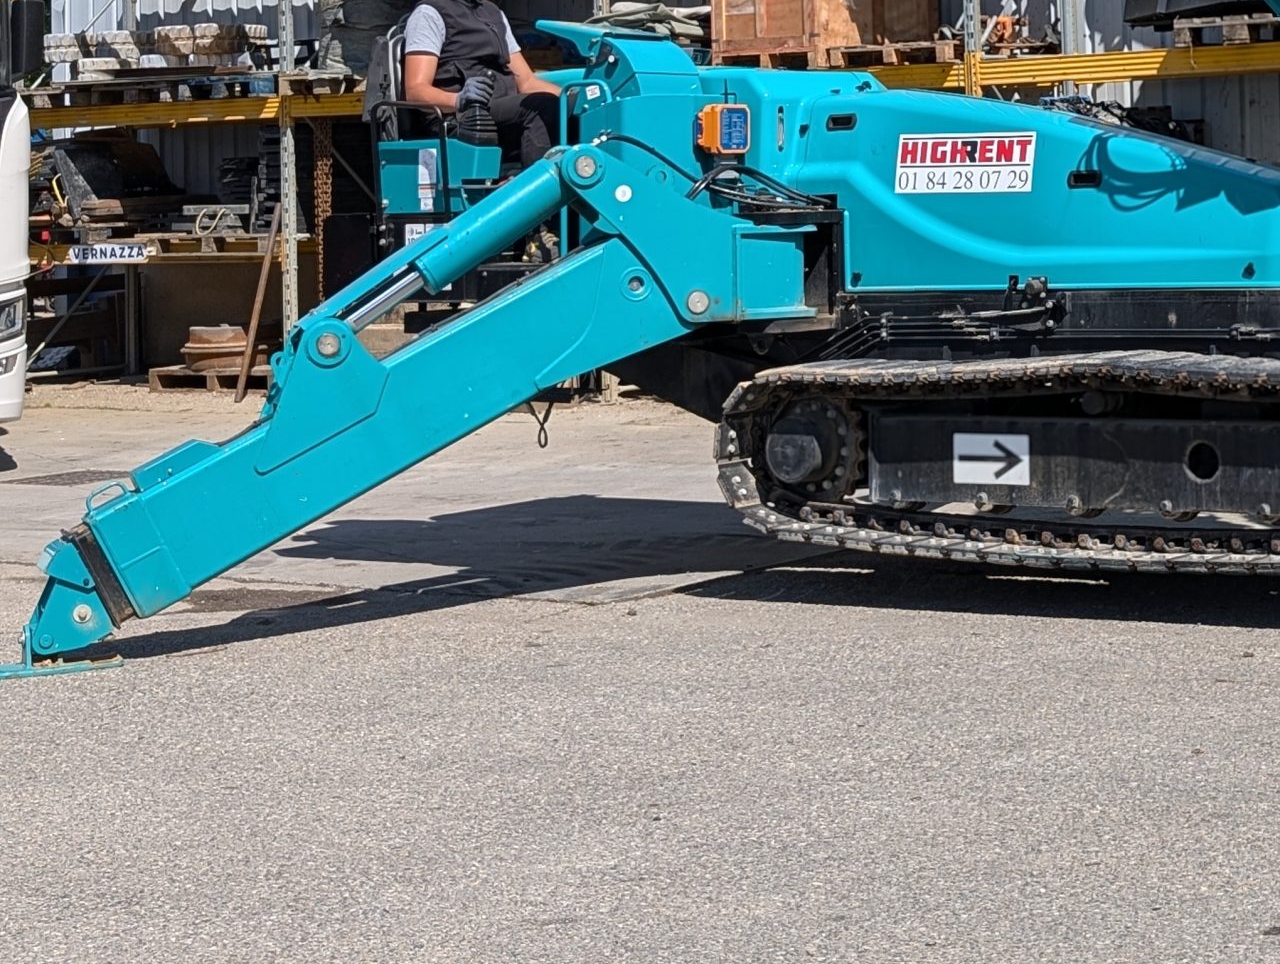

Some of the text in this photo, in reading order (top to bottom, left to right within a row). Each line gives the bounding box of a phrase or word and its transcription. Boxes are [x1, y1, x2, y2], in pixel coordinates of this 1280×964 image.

[900, 139, 1032, 164] HIGHRENT
[898, 169, 1029, 190] 01 84 28 07 29
[73, 246, 144, 259] VERNAZZA
